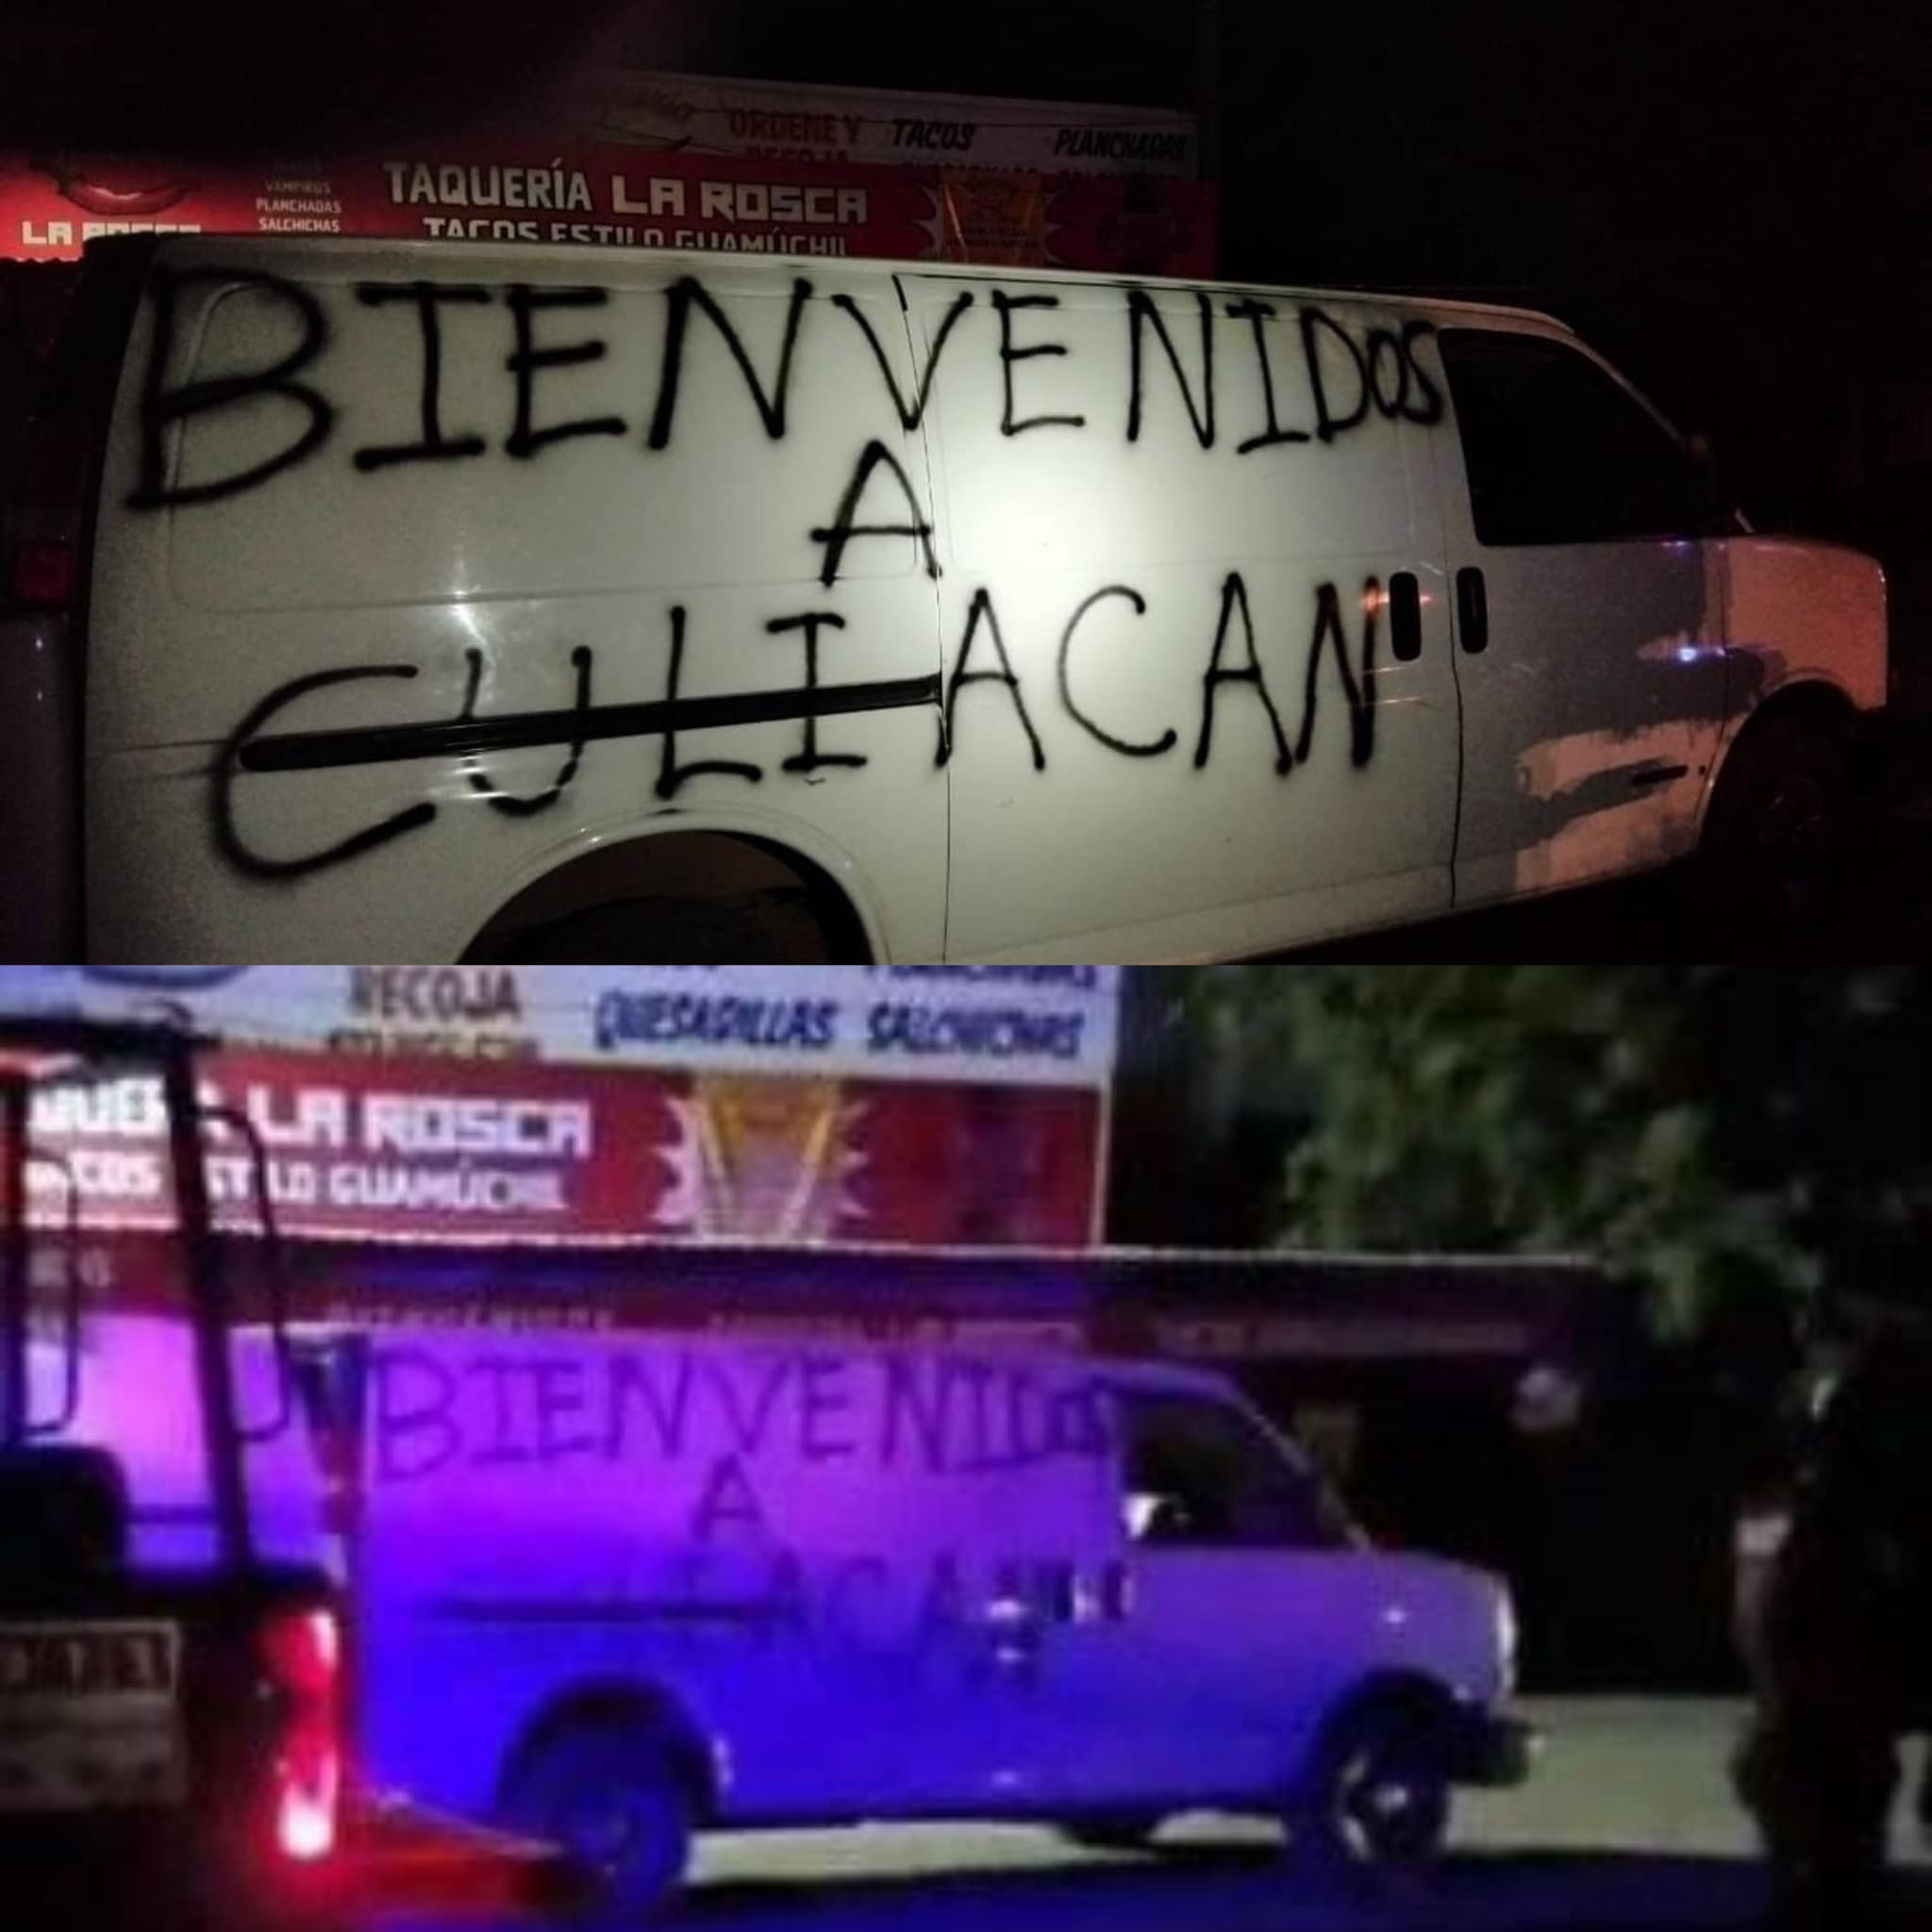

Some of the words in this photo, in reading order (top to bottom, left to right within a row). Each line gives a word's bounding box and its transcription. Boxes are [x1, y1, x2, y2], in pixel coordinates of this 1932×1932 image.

[892, 119, 975, 150] TACOS
[1053, 128, 1188, 161] PLANCHADAS
[256, 197, 341, 214] PLANCHADAS
[258, 216, 341, 234] SALCHICHAS
[382, 157, 593, 212] TAQUERÍA
[610, 174, 687, 218] LA
[699, 180, 868, 225] ROSCA
[23, 221, 73, 245] LA
[126, 268, 1445, 509] BIENVENIDOS
[810, 439, 943, 587] A
[210, 571, 1379, 882] CULIACAN
[246, 1082, 348, 1148] LA
[364, 1091, 591, 1159] ROSCA
[691, 1455, 766, 1543] A
